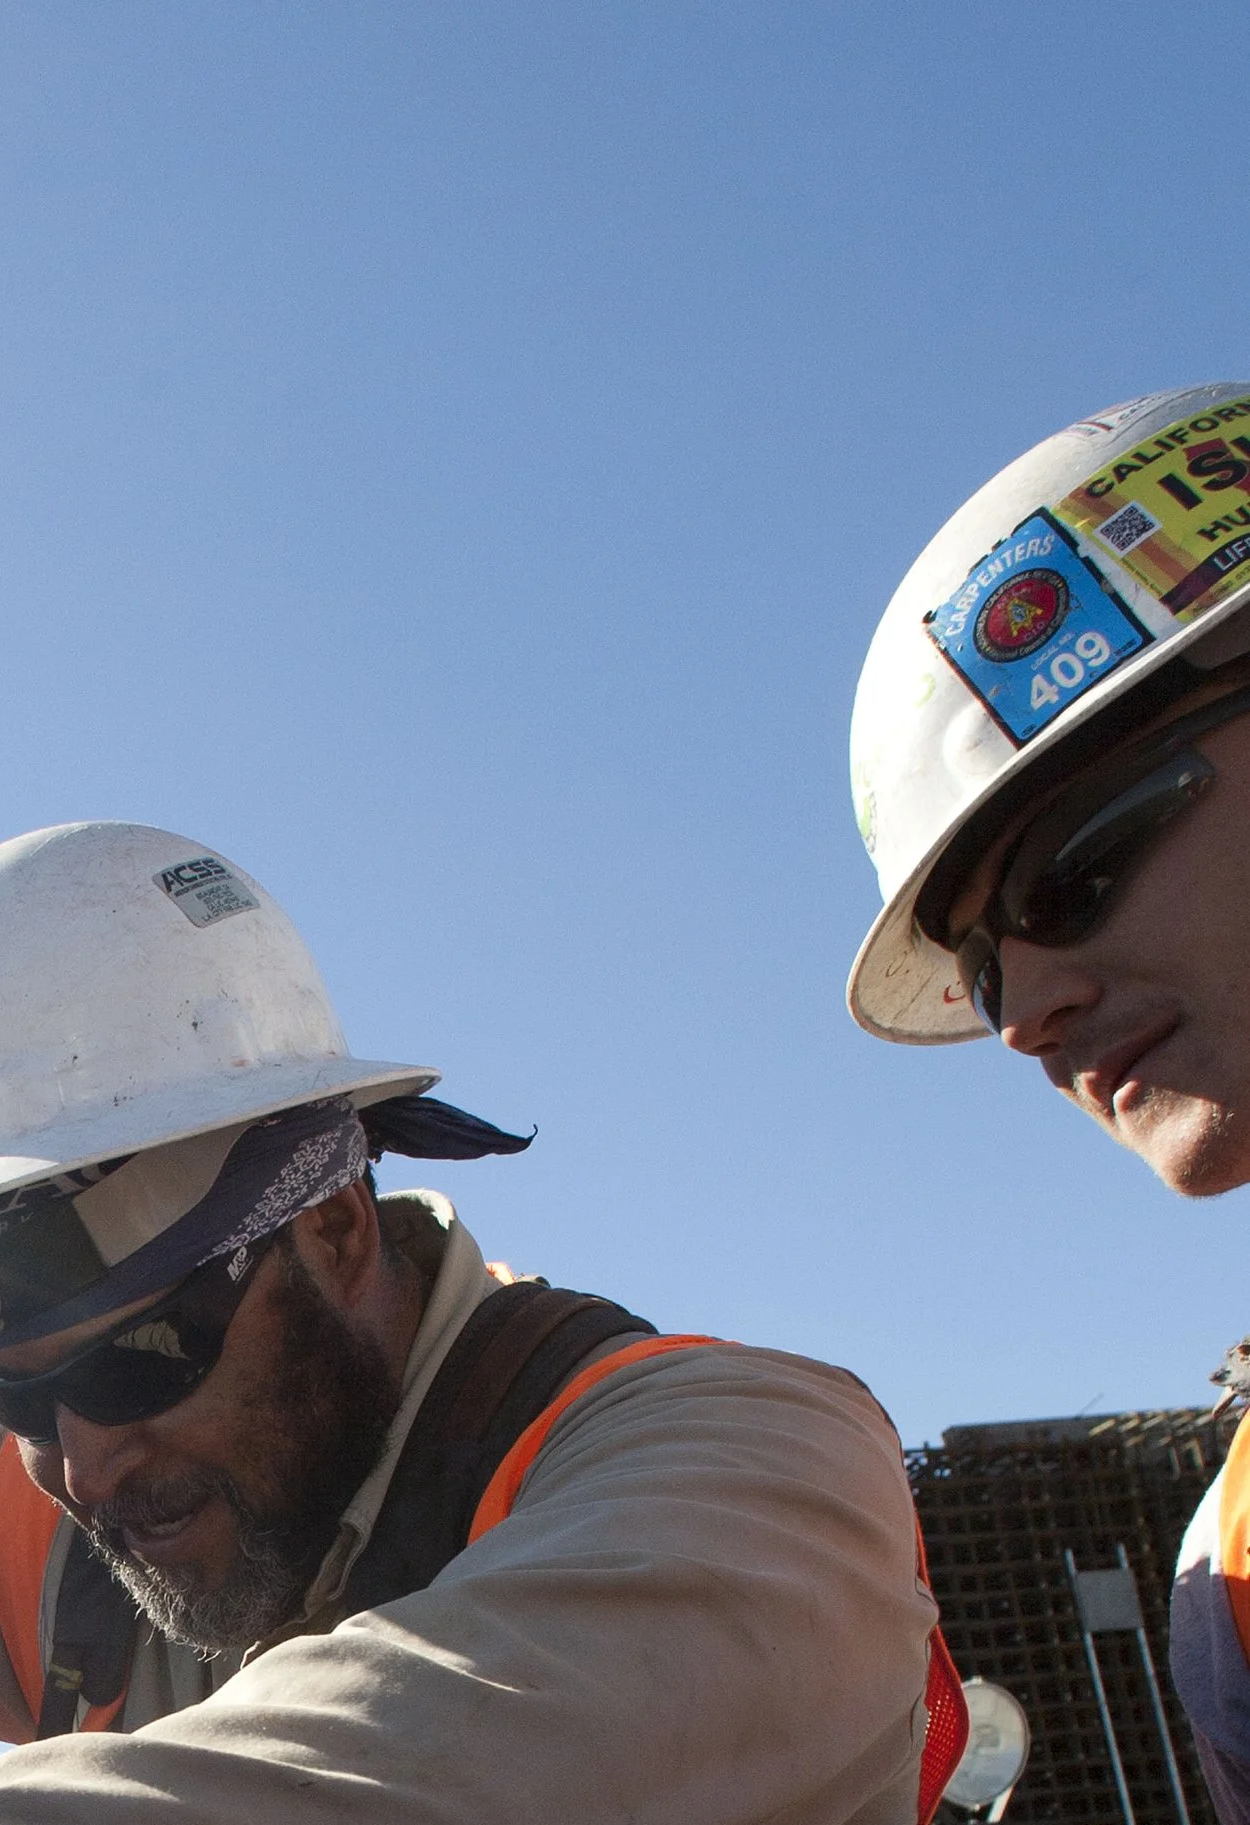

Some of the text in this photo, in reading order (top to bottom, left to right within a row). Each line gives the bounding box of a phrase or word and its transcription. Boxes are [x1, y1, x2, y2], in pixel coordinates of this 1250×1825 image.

[1197, 503, 1250, 542] HU
[946, 534, 1056, 637] CARPENTERS
[1031, 631, 1110, 710] 409
[160, 856, 226, 893] ACSS
